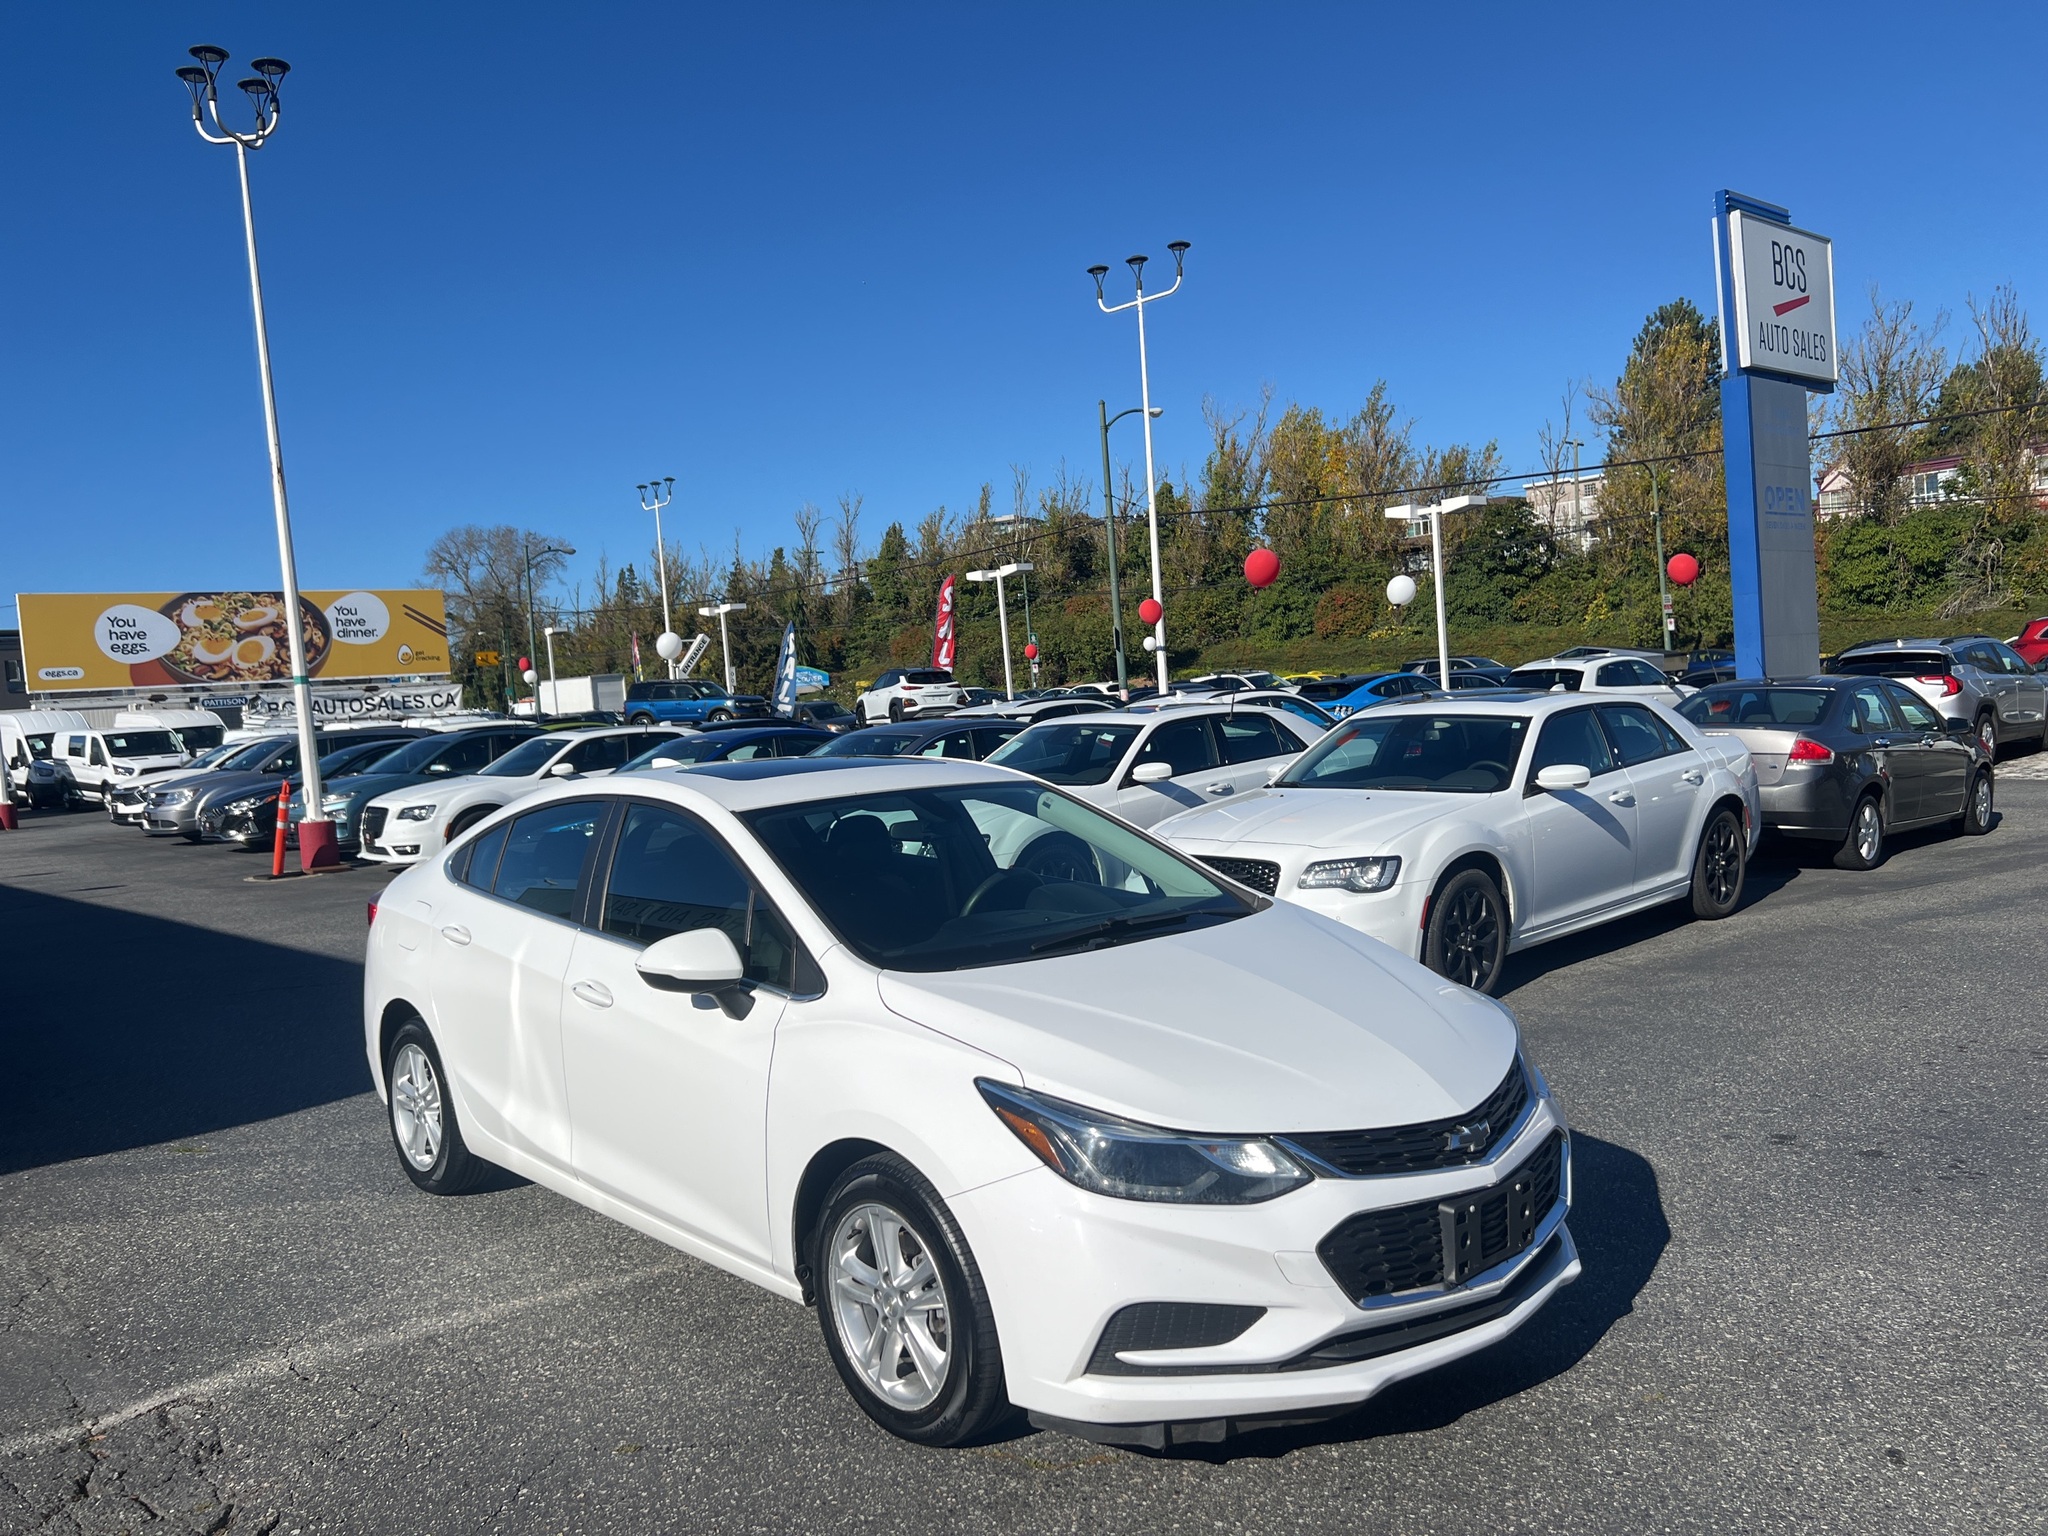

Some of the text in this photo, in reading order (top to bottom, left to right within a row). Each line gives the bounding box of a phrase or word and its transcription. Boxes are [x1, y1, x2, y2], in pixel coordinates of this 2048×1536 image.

[1771, 240, 1807, 293] BCS
[1759, 321, 1826, 362] AUTO SALES
[1764, 485, 1806, 511] OPEN
[334, 605, 358, 616] You
[106, 616, 137, 628] You
[335, 617, 366, 627] have
[108, 629, 148, 641] have
[336, 628, 379, 639] dinner.
[938, 586, 954, 674] SAL
[110, 642, 150, 655] eggs.
[682, 638, 708, 674] ENTRANCE
[44, 668, 79, 678] eggs.ca
[203, 698, 246, 707] PATTISON
[267, 693, 457, 718] BCAUTOSALES.CA
